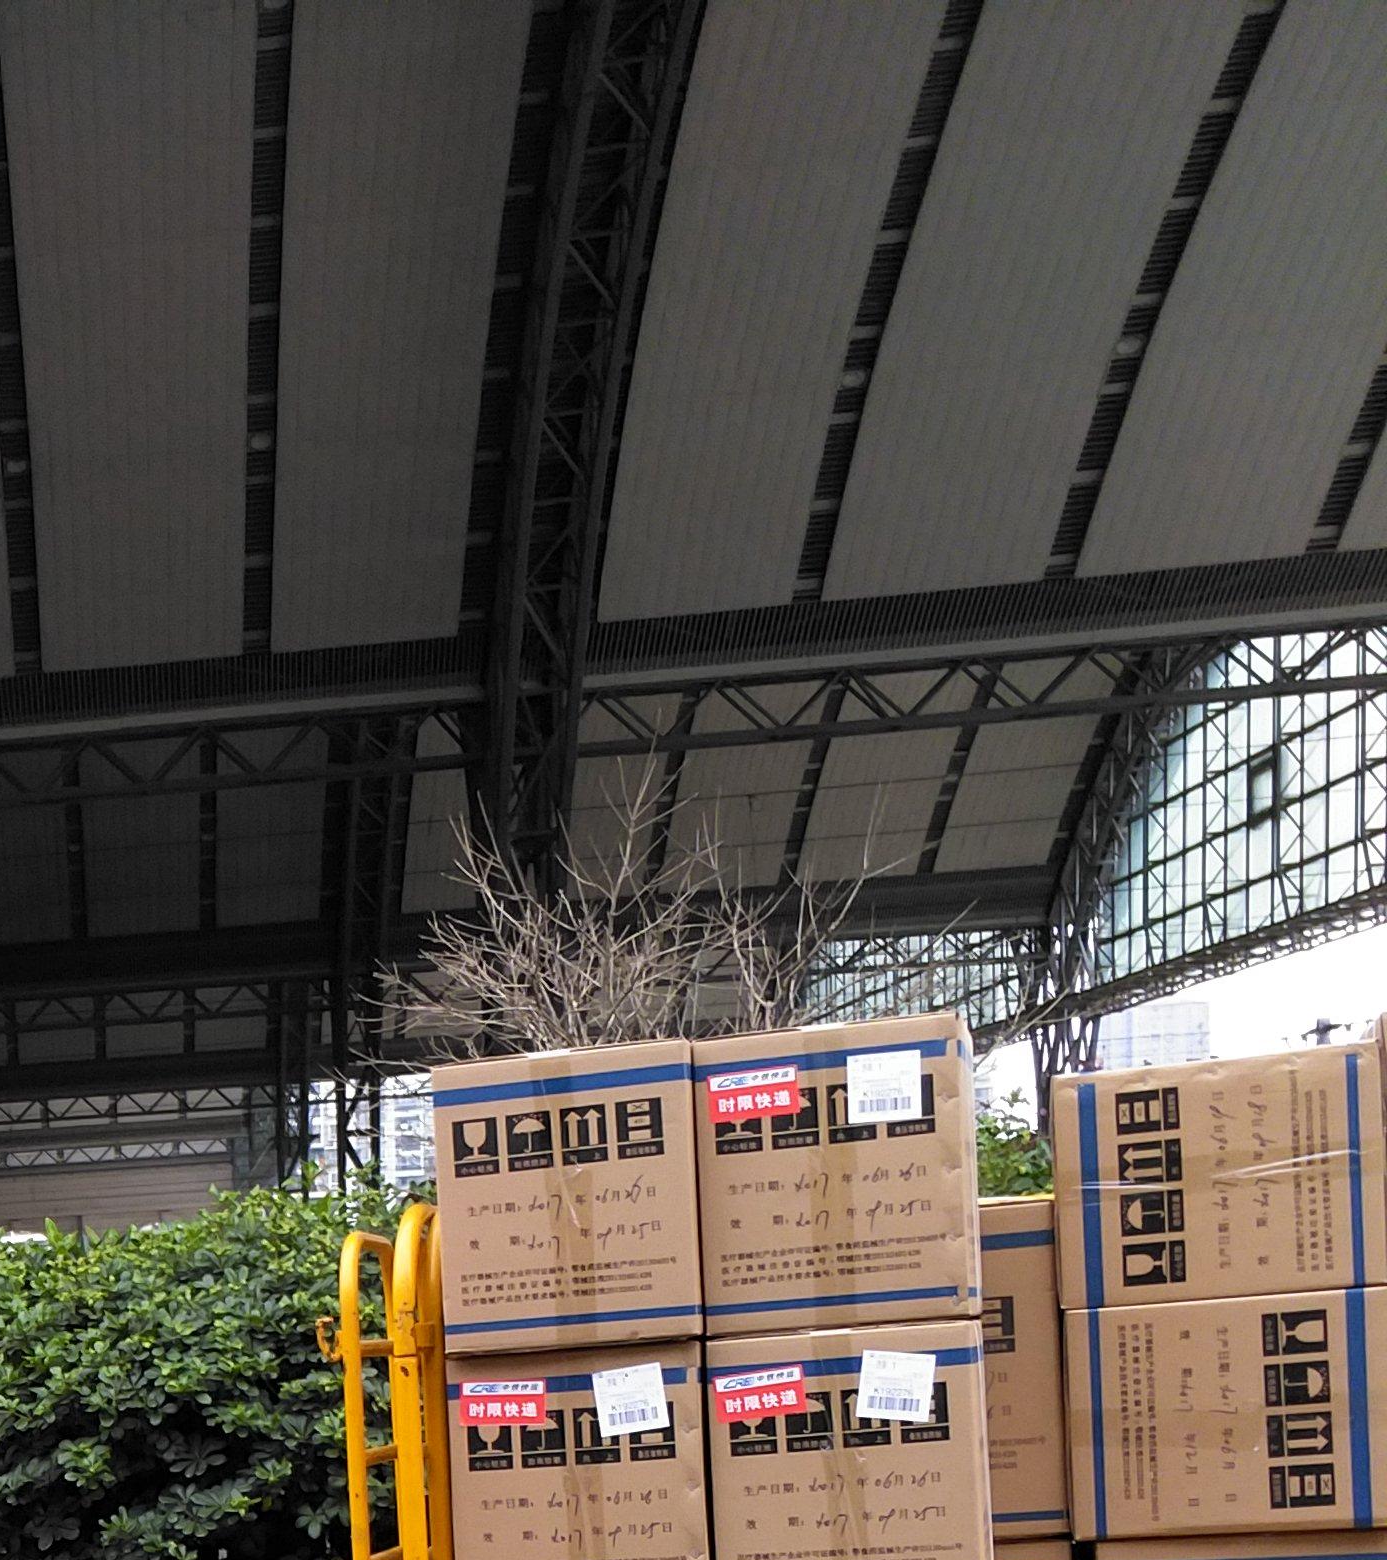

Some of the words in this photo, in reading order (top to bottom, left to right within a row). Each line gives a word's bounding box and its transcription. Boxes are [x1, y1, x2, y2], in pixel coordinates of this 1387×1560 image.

[718, 1089, 792, 1113] 时限快递
[469, 1402, 538, 1418] 时限快递
[725, 1389, 798, 1413] 时限快递
